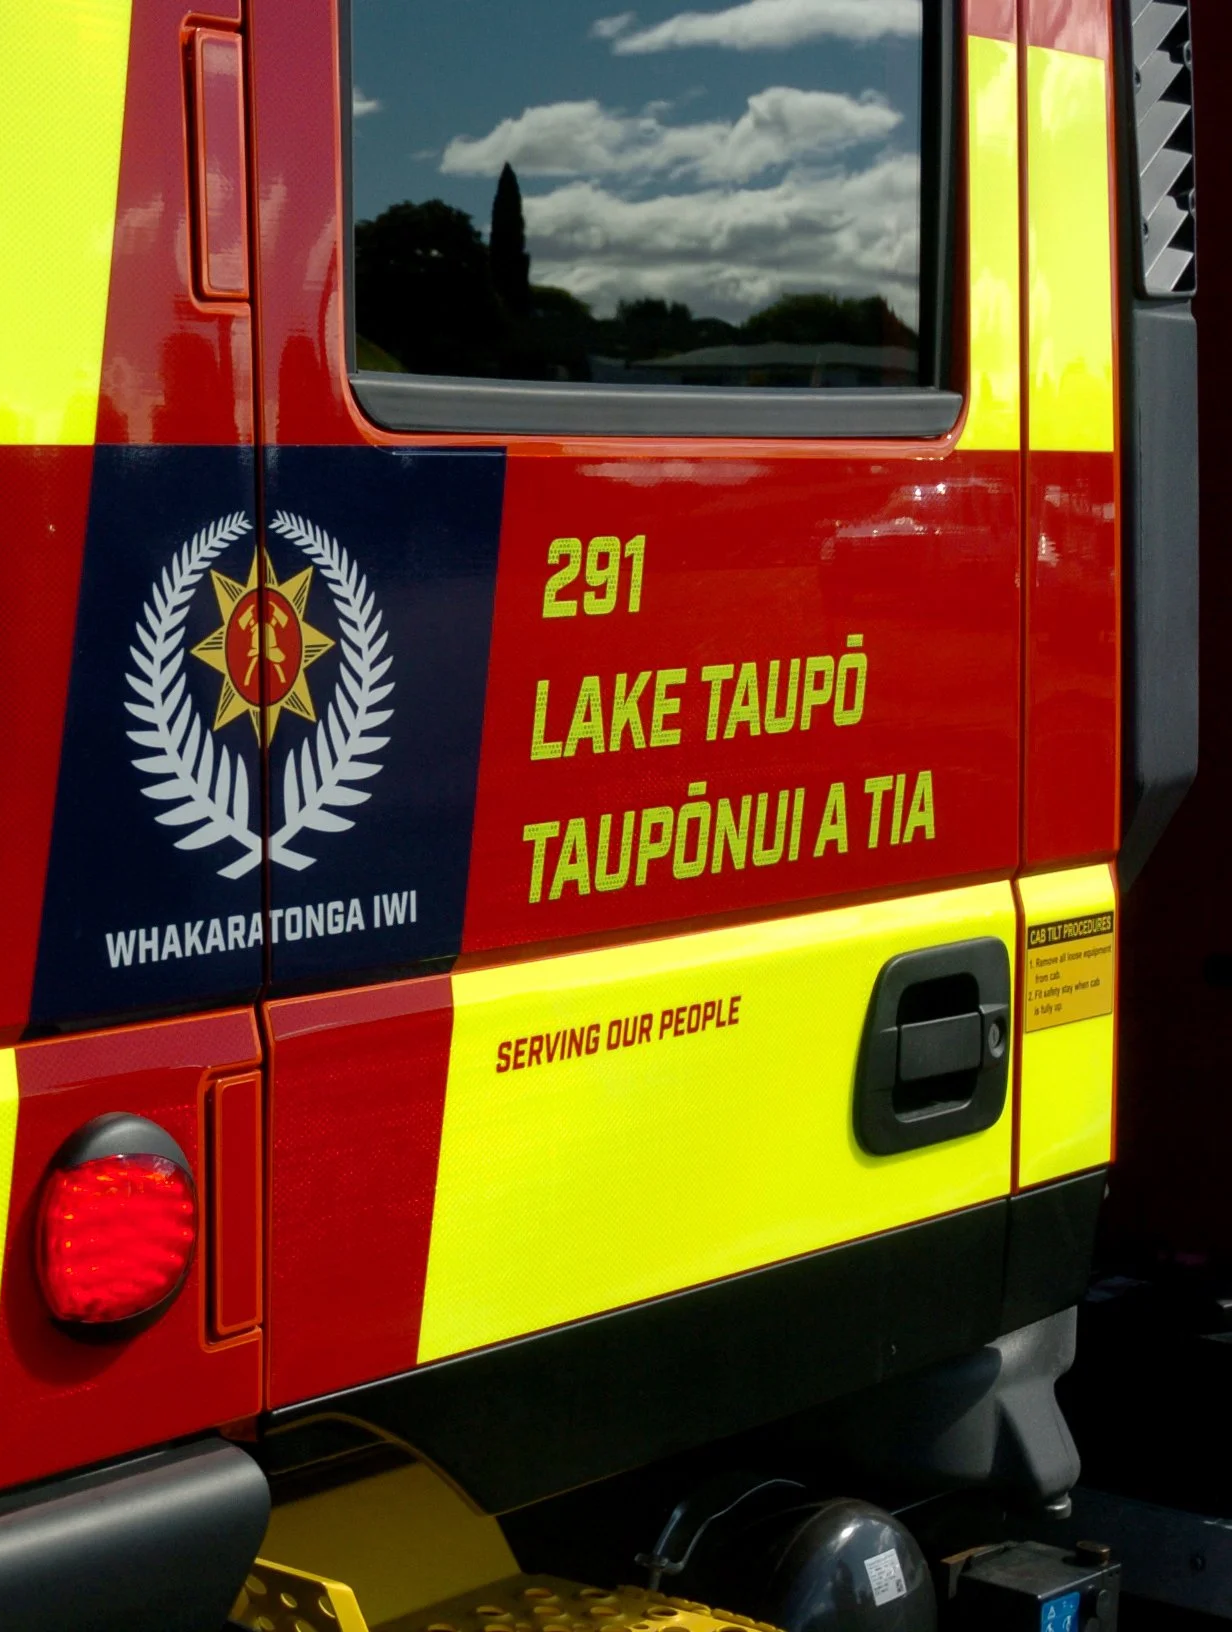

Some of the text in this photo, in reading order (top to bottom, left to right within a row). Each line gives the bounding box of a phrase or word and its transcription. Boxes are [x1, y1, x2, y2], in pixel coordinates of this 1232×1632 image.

[541, 534, 647, 618] 291
[530, 633, 868, 760] LAKE TAUPŌ
[522, 770, 936, 904] TAUPŌNUI A TIA
[105, 890, 418, 968] WHAKARATONGA IWI
[1030, 915, 1112, 945] CAB TILT PROCEDURES
[1035, 955, 1059, 968] Remove
[1067, 950, 1083, 961] loose
[1083, 945, 1112, 959] equipment
[1035, 971, 1061, 984] from cab
[1034, 988, 1043, 999] Fit
[1044, 985, 1061, 999] safety
[1062, 983, 1073, 995] stay
[1074, 980, 1090, 991] when
[1090, 977, 1100, 987] cab
[1041, 1003, 1053, 1015] fully
[496, 995, 742, 1073] SERVING OUR PEOPLE
